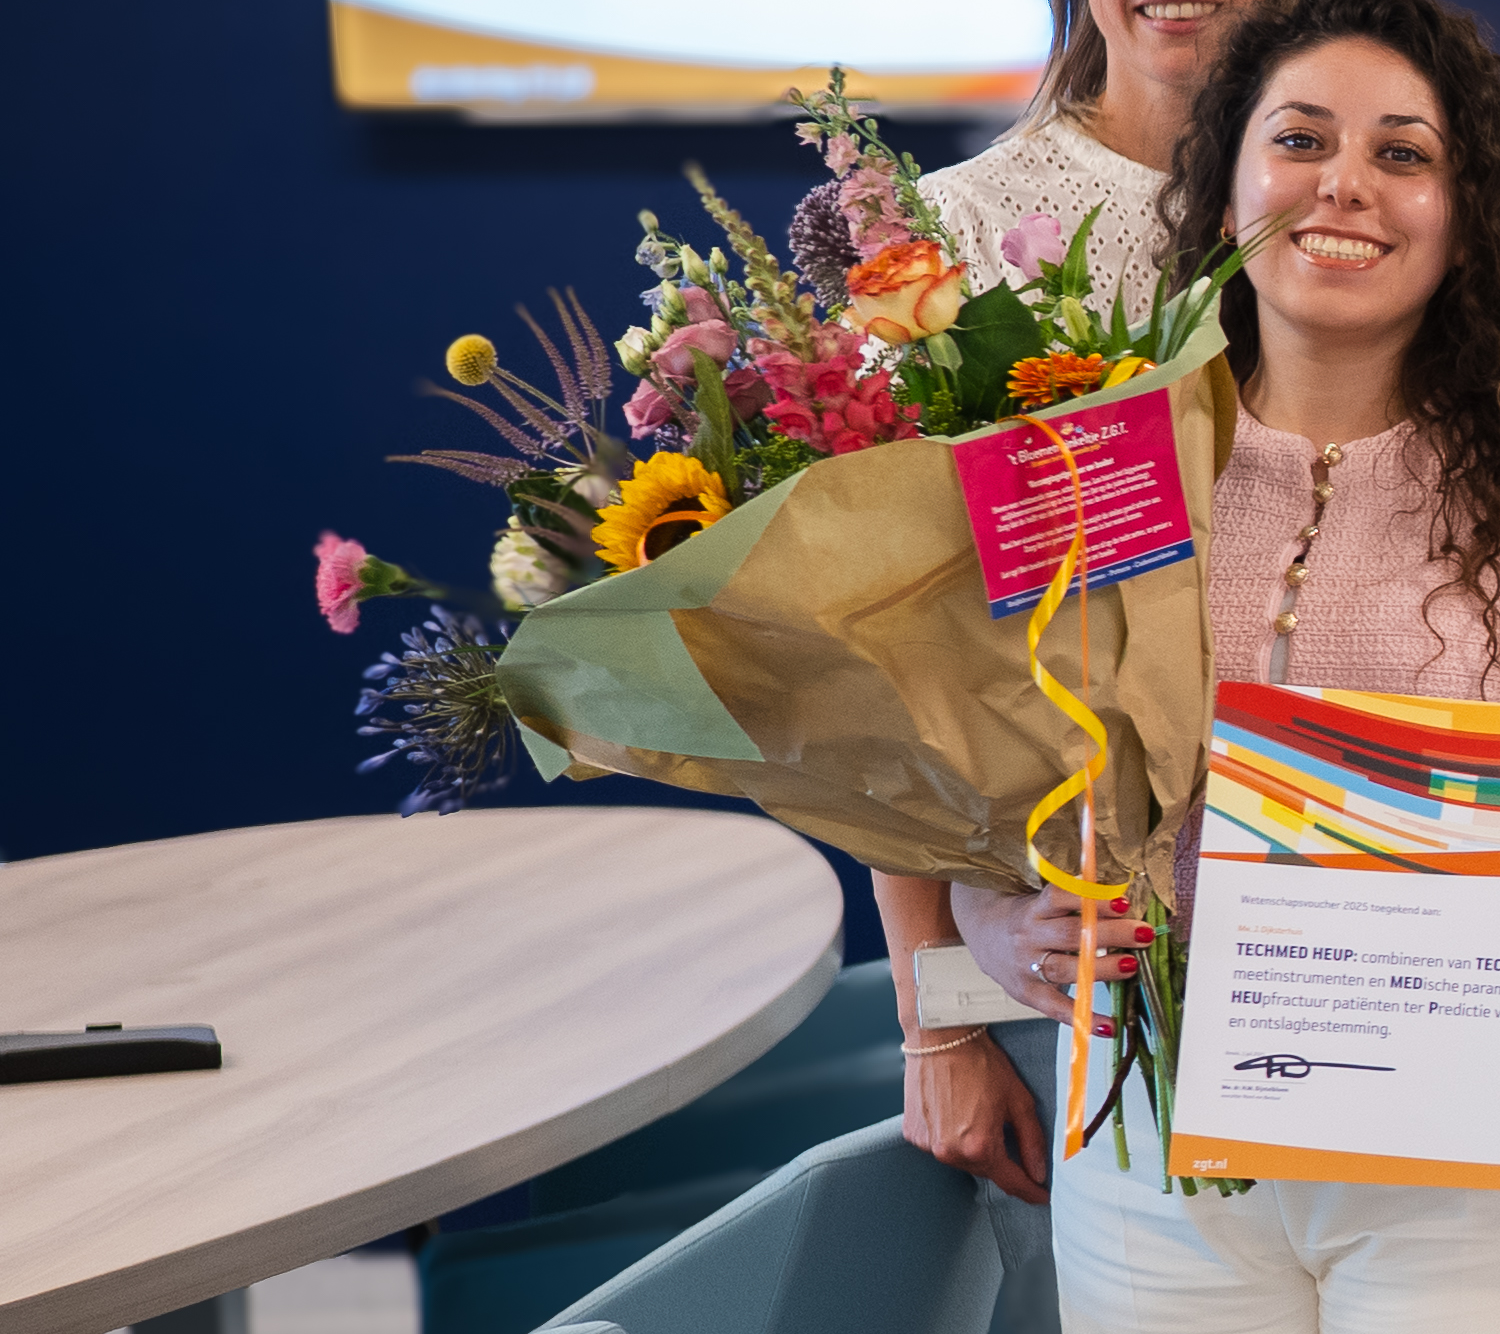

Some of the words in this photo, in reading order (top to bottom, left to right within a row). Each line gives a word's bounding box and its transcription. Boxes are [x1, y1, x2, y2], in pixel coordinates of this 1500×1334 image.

[1240, 894, 1340, 910] Wetenschapsvoucher
[1343, 901, 1368, 911] 2025
[1370, 904, 1420, 915] toegekend
[1236, 943, 1308, 959] TECHMED
[1312, 947, 1358, 962] HEUP:
[1361, 951, 1443, 967] combineren
[1448, 958, 1471, 969] van
[1233, 968, 1365, 987] meetinstrumenten
[1369, 977, 1386, 988] en
[1390, 975, 1459, 992] MEDische
[1231, 990, 1330, 1008] HEUpfractuur
[1332, 997, 1400, 1012] patiënten
[1404, 1000, 1425, 1013] ter
[1429, 1001, 1491, 1018] Predictie
[1228, 1017, 1246, 1028] en
[1249, 1016, 1392, 1039] ontslagbestemming.
[1192, 1158, 1228, 1171] zgt.nl
